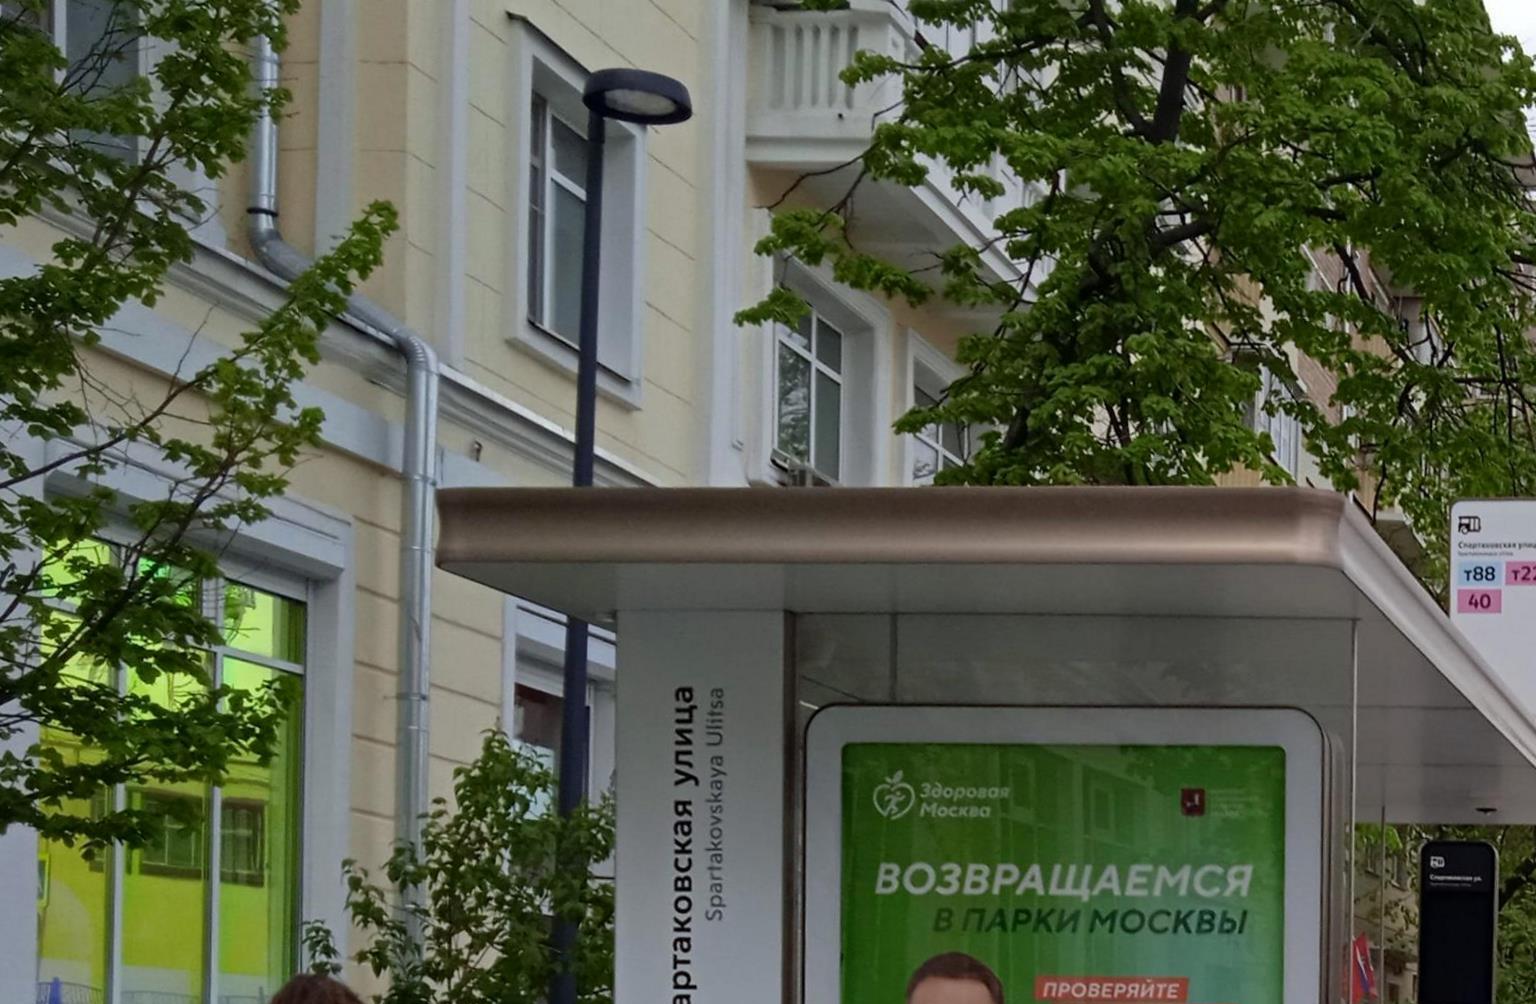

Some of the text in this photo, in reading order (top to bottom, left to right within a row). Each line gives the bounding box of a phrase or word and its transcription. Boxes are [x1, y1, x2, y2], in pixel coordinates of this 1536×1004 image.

[1468, 593, 1491, 609] 40
[673, 685, 699, 786] улица
[705, 687, 728, 921] Spartakovskaya Ulitsa
[919, 782, 1011, 802] Здоровая
[919, 802, 991, 818] Москва
[874, 861, 1253, 901] ВОЗВРАЩАЕМСЯ
[932, 907, 1249, 935] В ПАРКИ МОСКВЫ
[1042, 979, 1180, 999] ПРОВЕРЯЙТЕ
